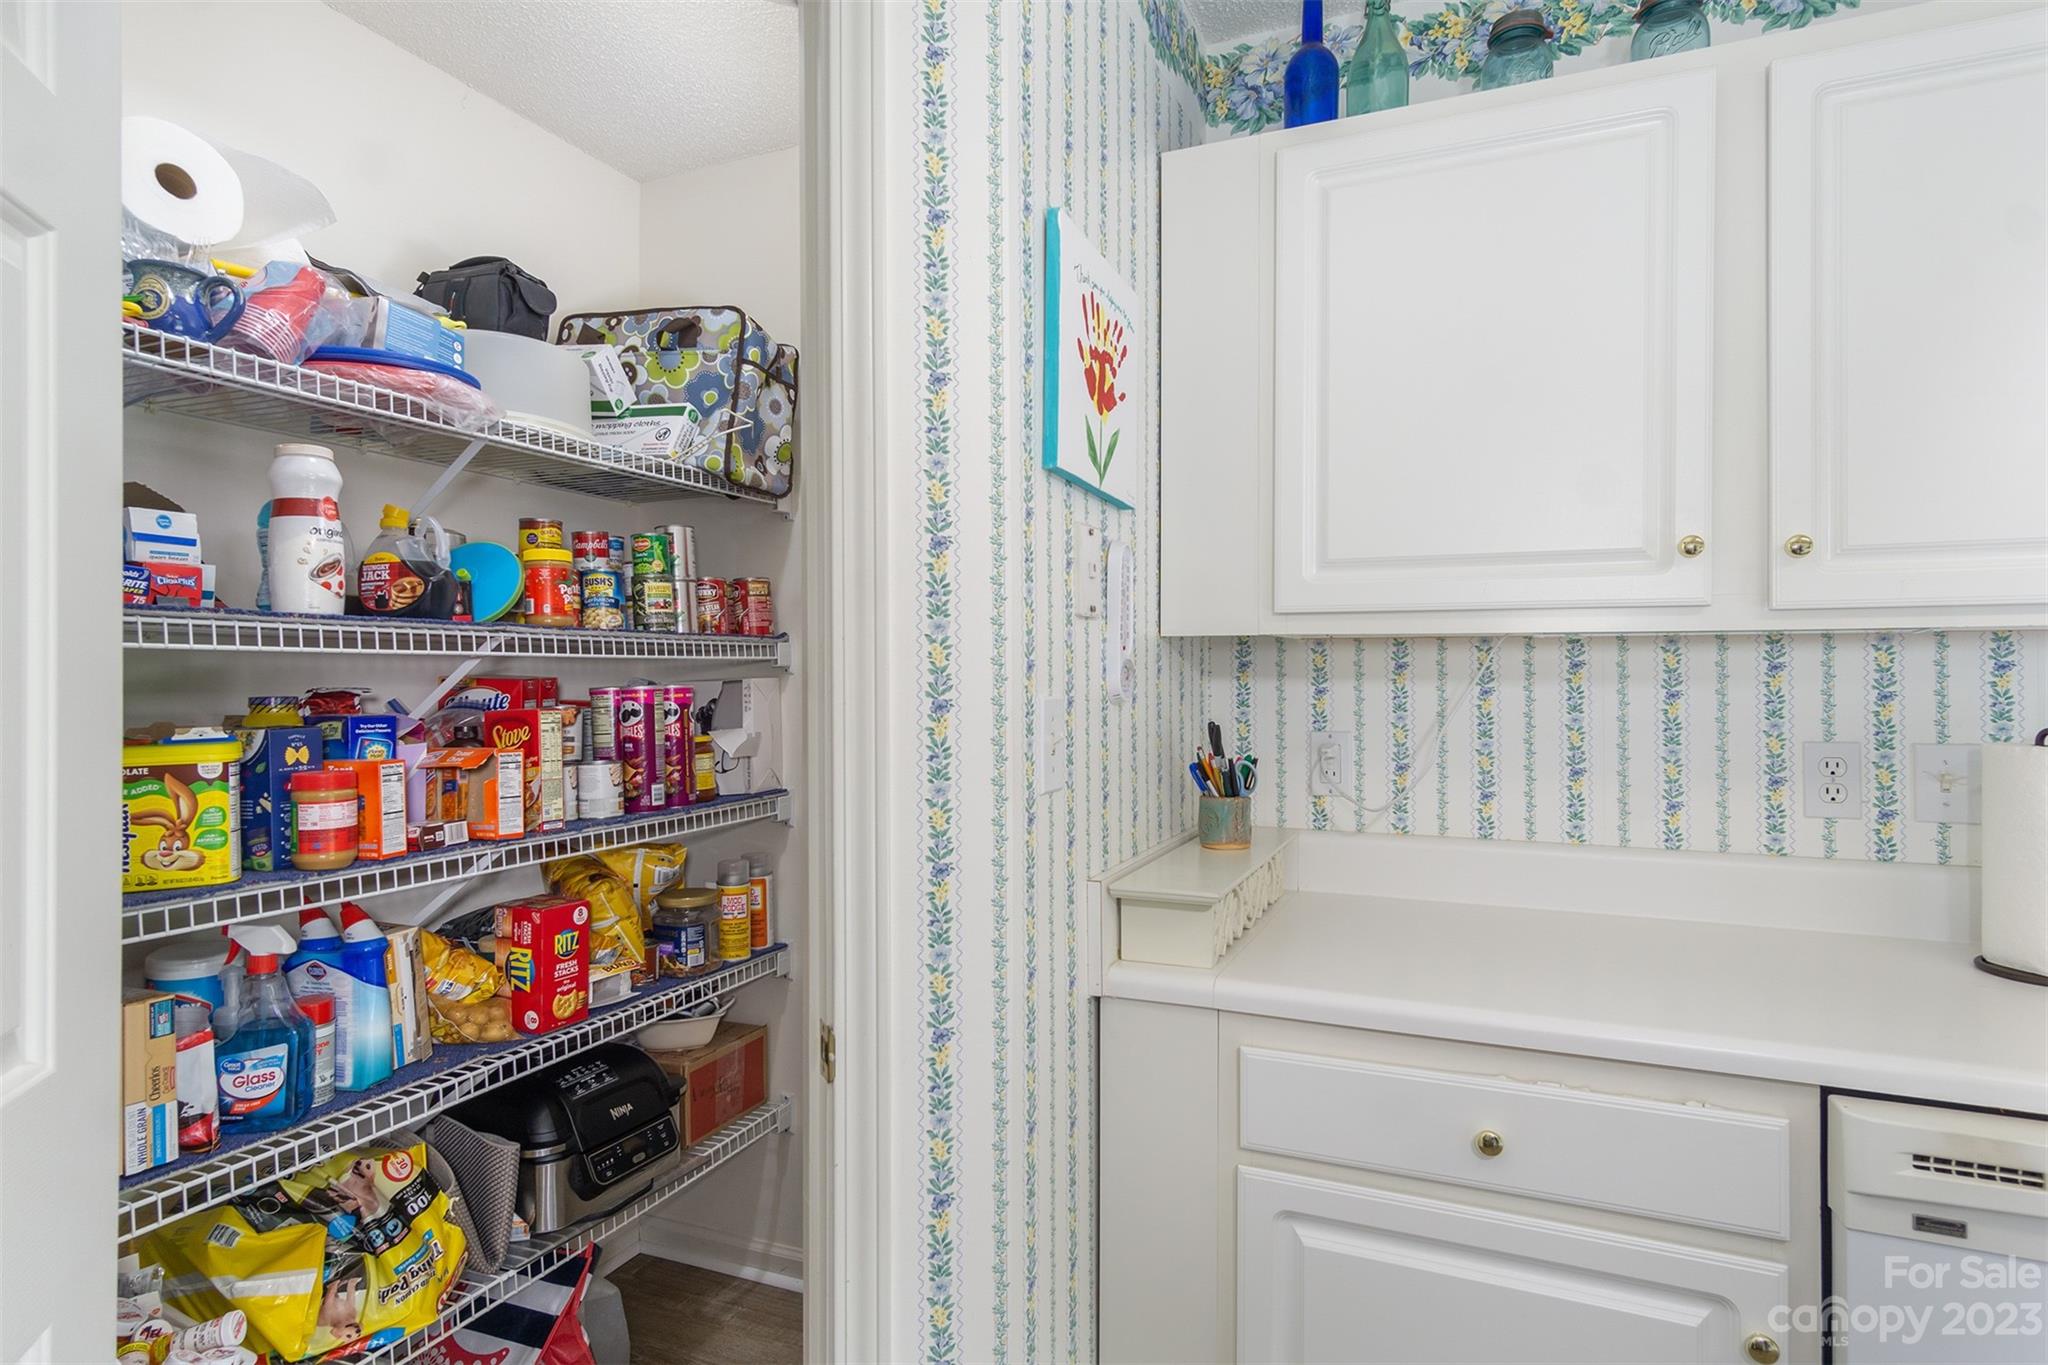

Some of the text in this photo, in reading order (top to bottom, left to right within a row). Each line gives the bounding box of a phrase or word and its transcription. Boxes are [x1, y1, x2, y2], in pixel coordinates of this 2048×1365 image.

[361, 570, 391, 581] JACK
[132, 595, 147, 605] 75
[492, 725, 532, 750] Stove
[121, 768, 149, 776] OLATE
[130, 784, 160, 796] ADDED
[554, 930, 580, 956] RITZ
[511, 947, 533, 993] RITZ
[554, 965, 579, 978] STACKS
[556, 959, 578, 971] FRESH
[232, 1071, 277, 1089] Glass
[245, 1082, 276, 1093] Cleaner
[609, 1103, 634, 1121] NINJA
[137, 1107, 148, 1167] WHOLE GRAIN
[406, 1190, 433, 1216] 100
